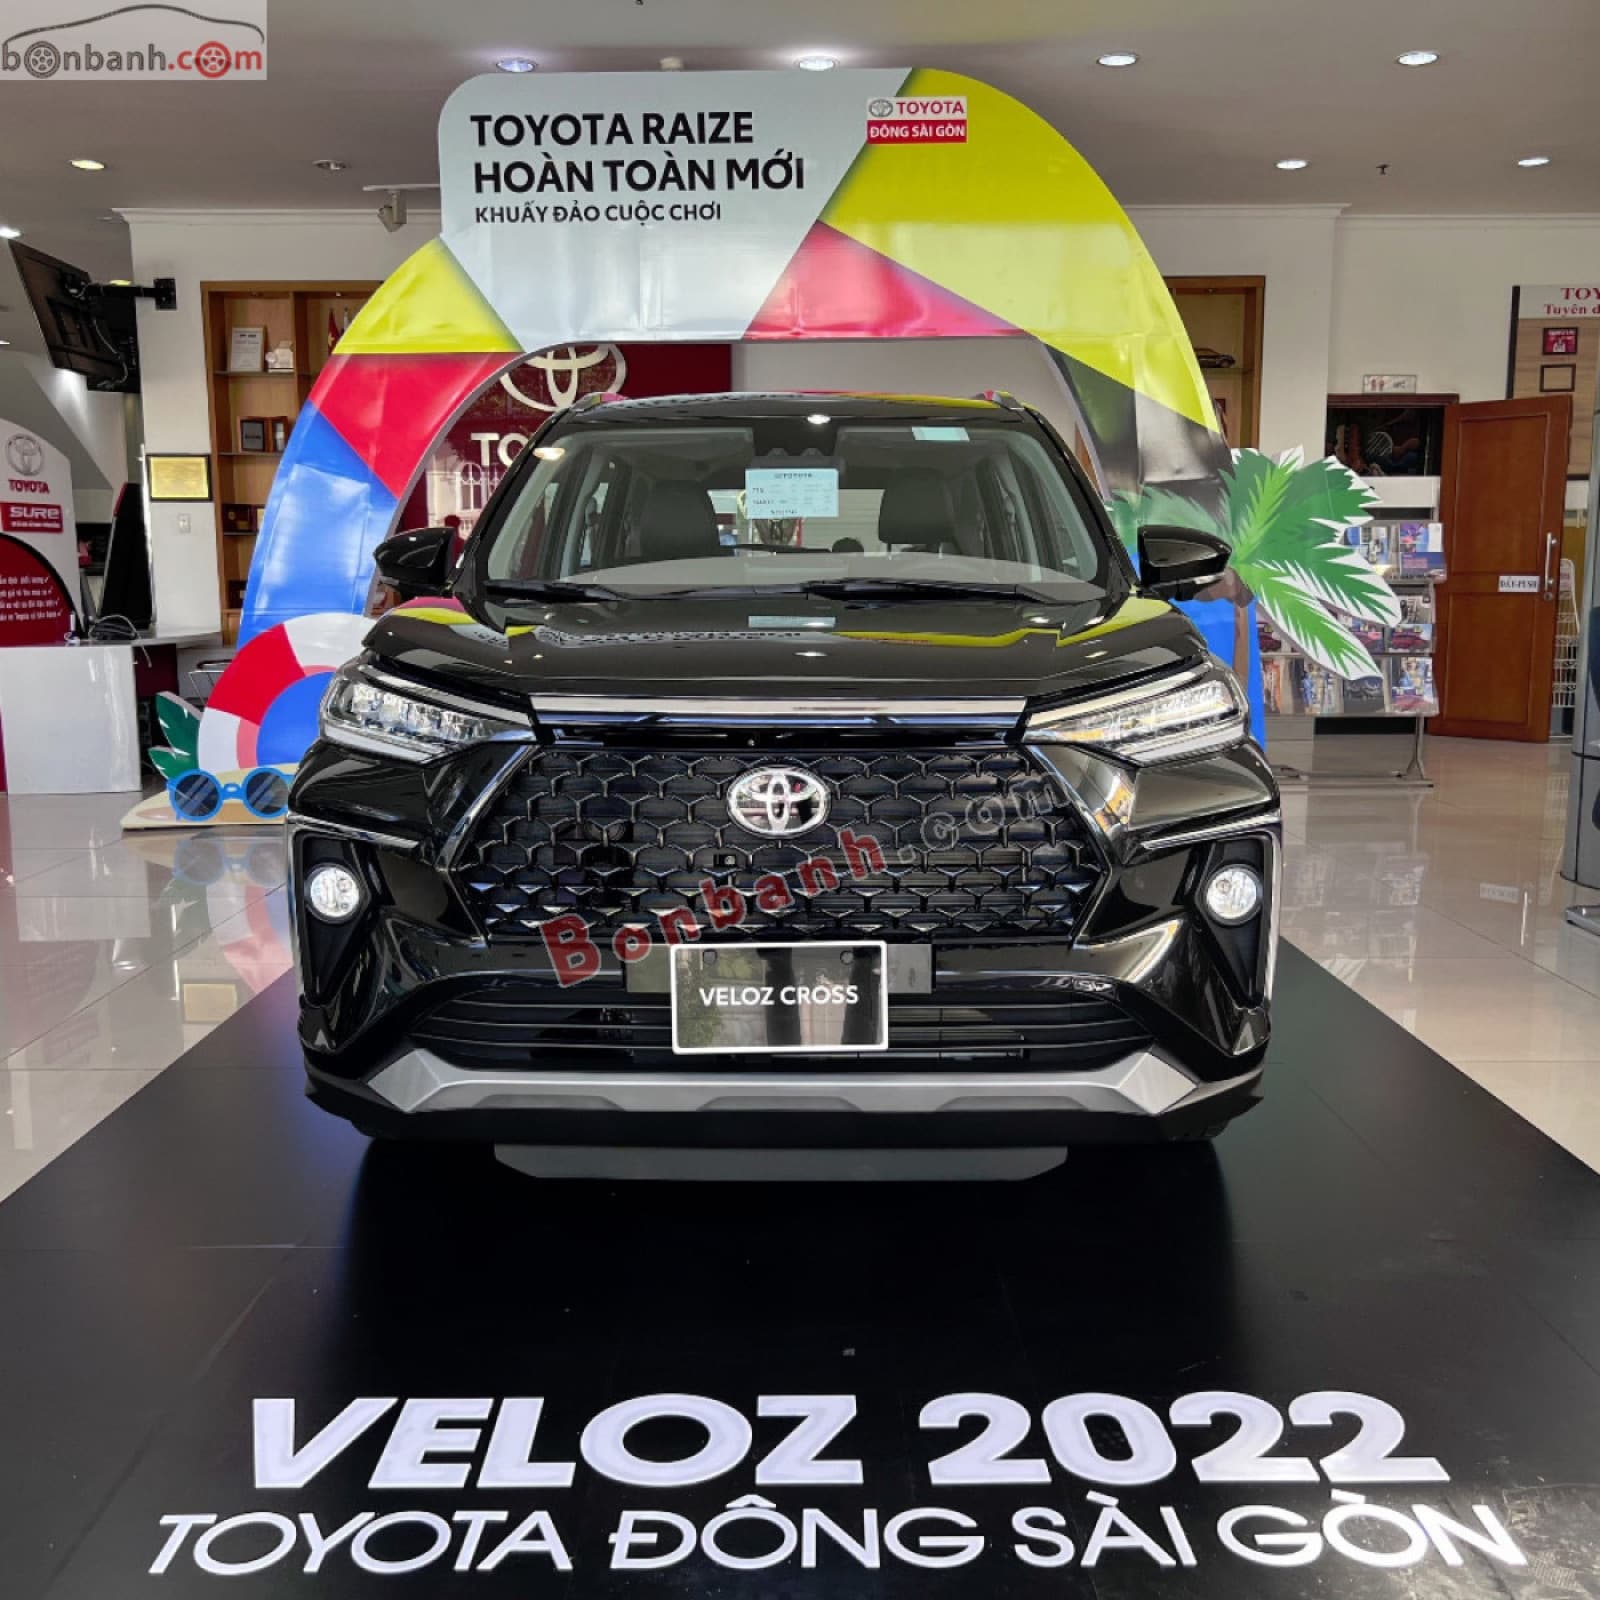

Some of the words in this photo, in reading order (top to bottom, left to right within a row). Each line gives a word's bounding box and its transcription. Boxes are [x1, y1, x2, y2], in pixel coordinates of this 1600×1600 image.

[896, 101, 965, 114] TOYOTA
[470, 112, 634, 146] TOYOTA
[642, 111, 754, 145] RAIZE
[911, 123, 933, 137] SÀI
[935, 123, 965, 137] GÒN
[474, 151, 594, 194] HOÀN
[602, 150, 716, 192] TOÀN
[726, 148, 805, 190] MỚI
[475, 200, 548, 223] KHUẤY
[552, 199, 600, 222] ĐẢO
[604, 200, 665, 226] CUỘC
[669, 201, 721, 221] CHƠI
[8, 479, 50, 495] TOYOTA
[699, 986, 775, 1007] VELOZ
[780, 985, 859, 1006] CROSS
[252, 1393, 864, 1489] VELOZ
[918, 1391, 1450, 1485] 2022
[149, 1510, 576, 1575] TOYOTA
[609, 1493, 985, 1571] ĐÔNG
[1011, 1490, 1198, 1568] SÀI
[1216, 1488, 1528, 1568] GÒN
